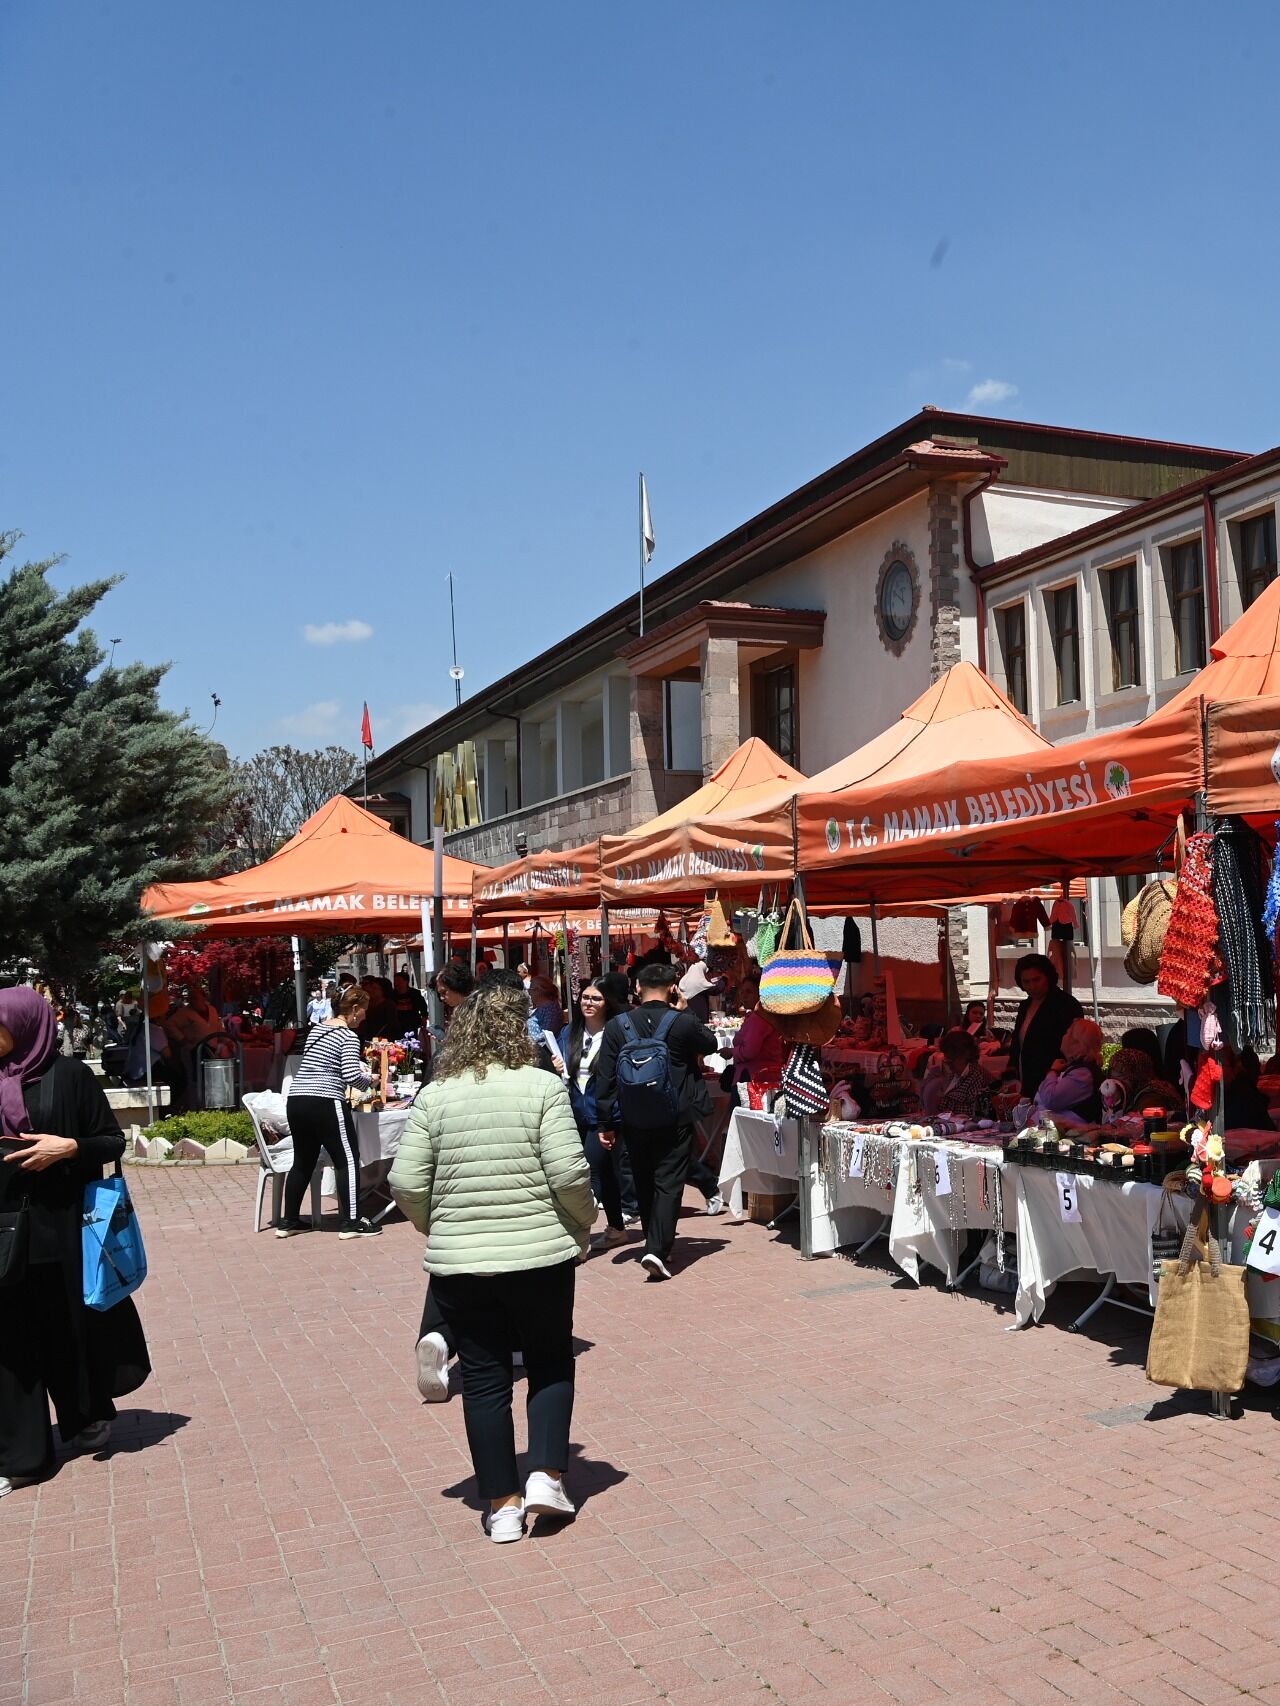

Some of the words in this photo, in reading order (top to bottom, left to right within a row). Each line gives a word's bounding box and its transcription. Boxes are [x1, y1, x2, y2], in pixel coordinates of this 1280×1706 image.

[845, 815, 877, 849] T.C.
[883, 799, 961, 844] MAMAK
[965, 760, 1098, 828] BELEDİYESİ
[647, 853, 685, 882] MAMAK
[273, 894, 365, 912] MAMAK
[934, 1165, 940, 1184] 6
[1063, 1189, 1072, 1210] 5
[1258, 1229, 1277, 1255] 4
